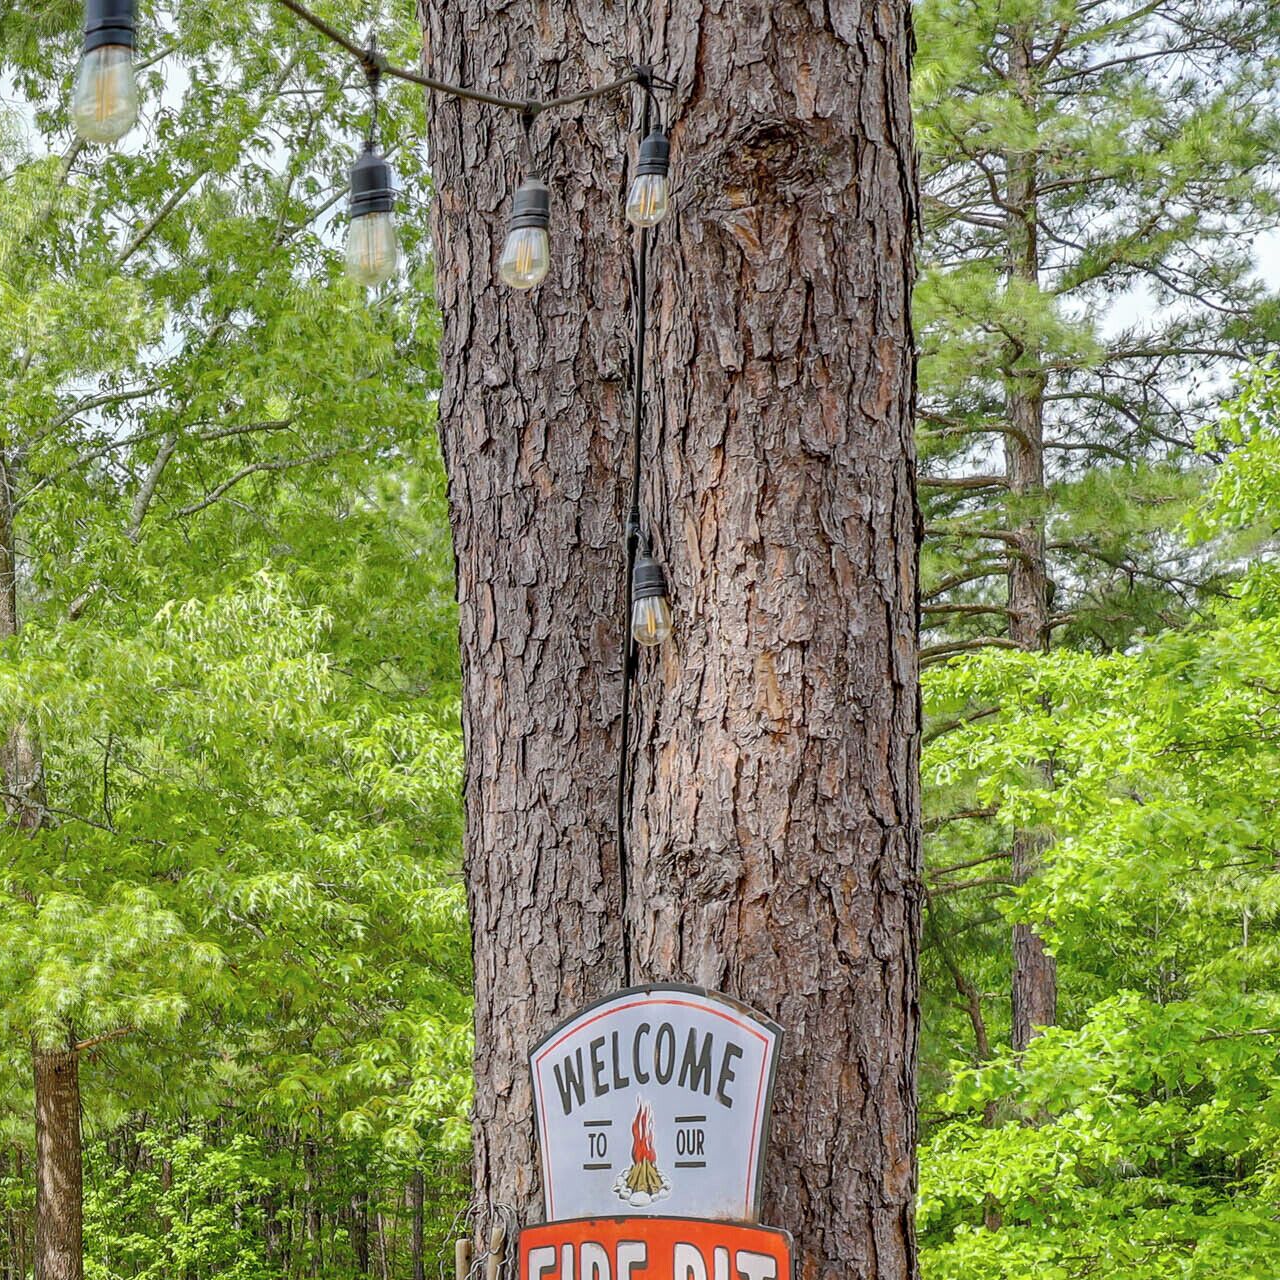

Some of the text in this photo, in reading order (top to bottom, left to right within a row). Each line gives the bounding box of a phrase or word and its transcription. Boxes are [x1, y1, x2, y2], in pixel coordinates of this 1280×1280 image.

[553, 1022, 743, 1116] WELCOME
[588, 1129, 705, 1158] TO OUR
